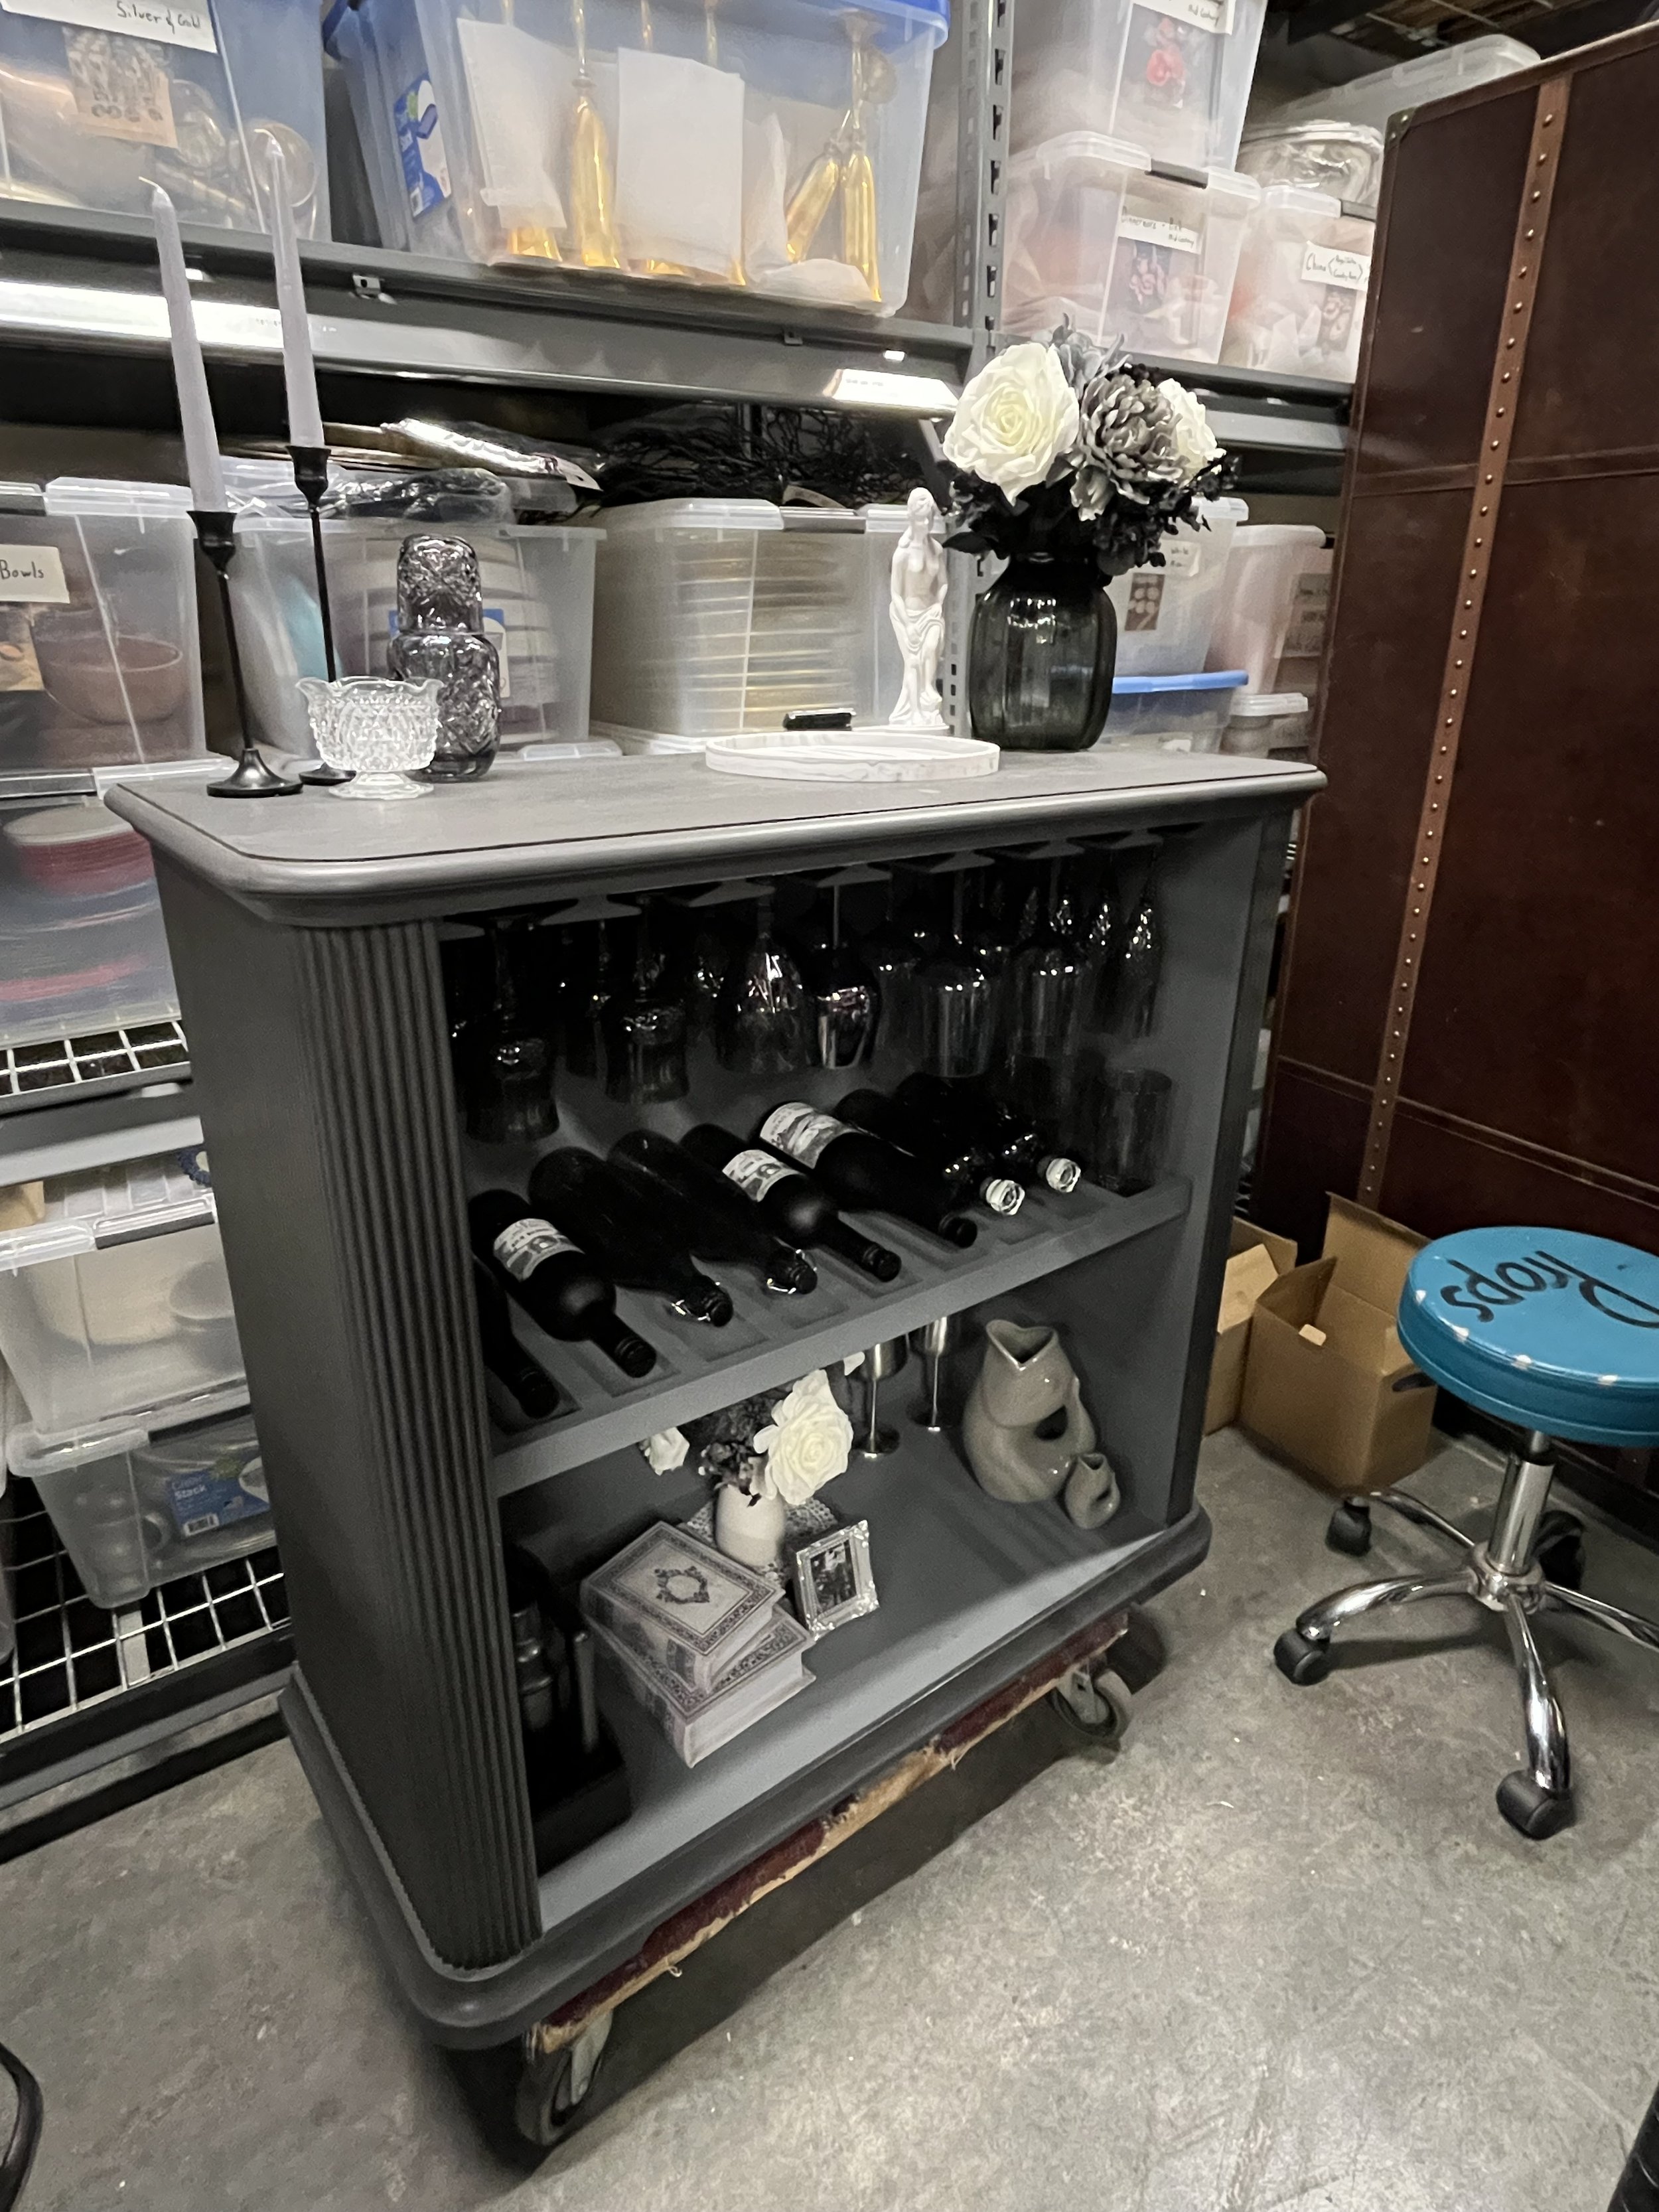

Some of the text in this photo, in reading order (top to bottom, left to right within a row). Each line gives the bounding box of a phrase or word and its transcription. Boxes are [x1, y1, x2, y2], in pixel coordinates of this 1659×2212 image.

[116, 0, 161, 23] Silver
[177, 13, 201, 29] Gold
[0, 559, 44, 580] Bowls
[1440, 1250, 1659, 1329] Props
